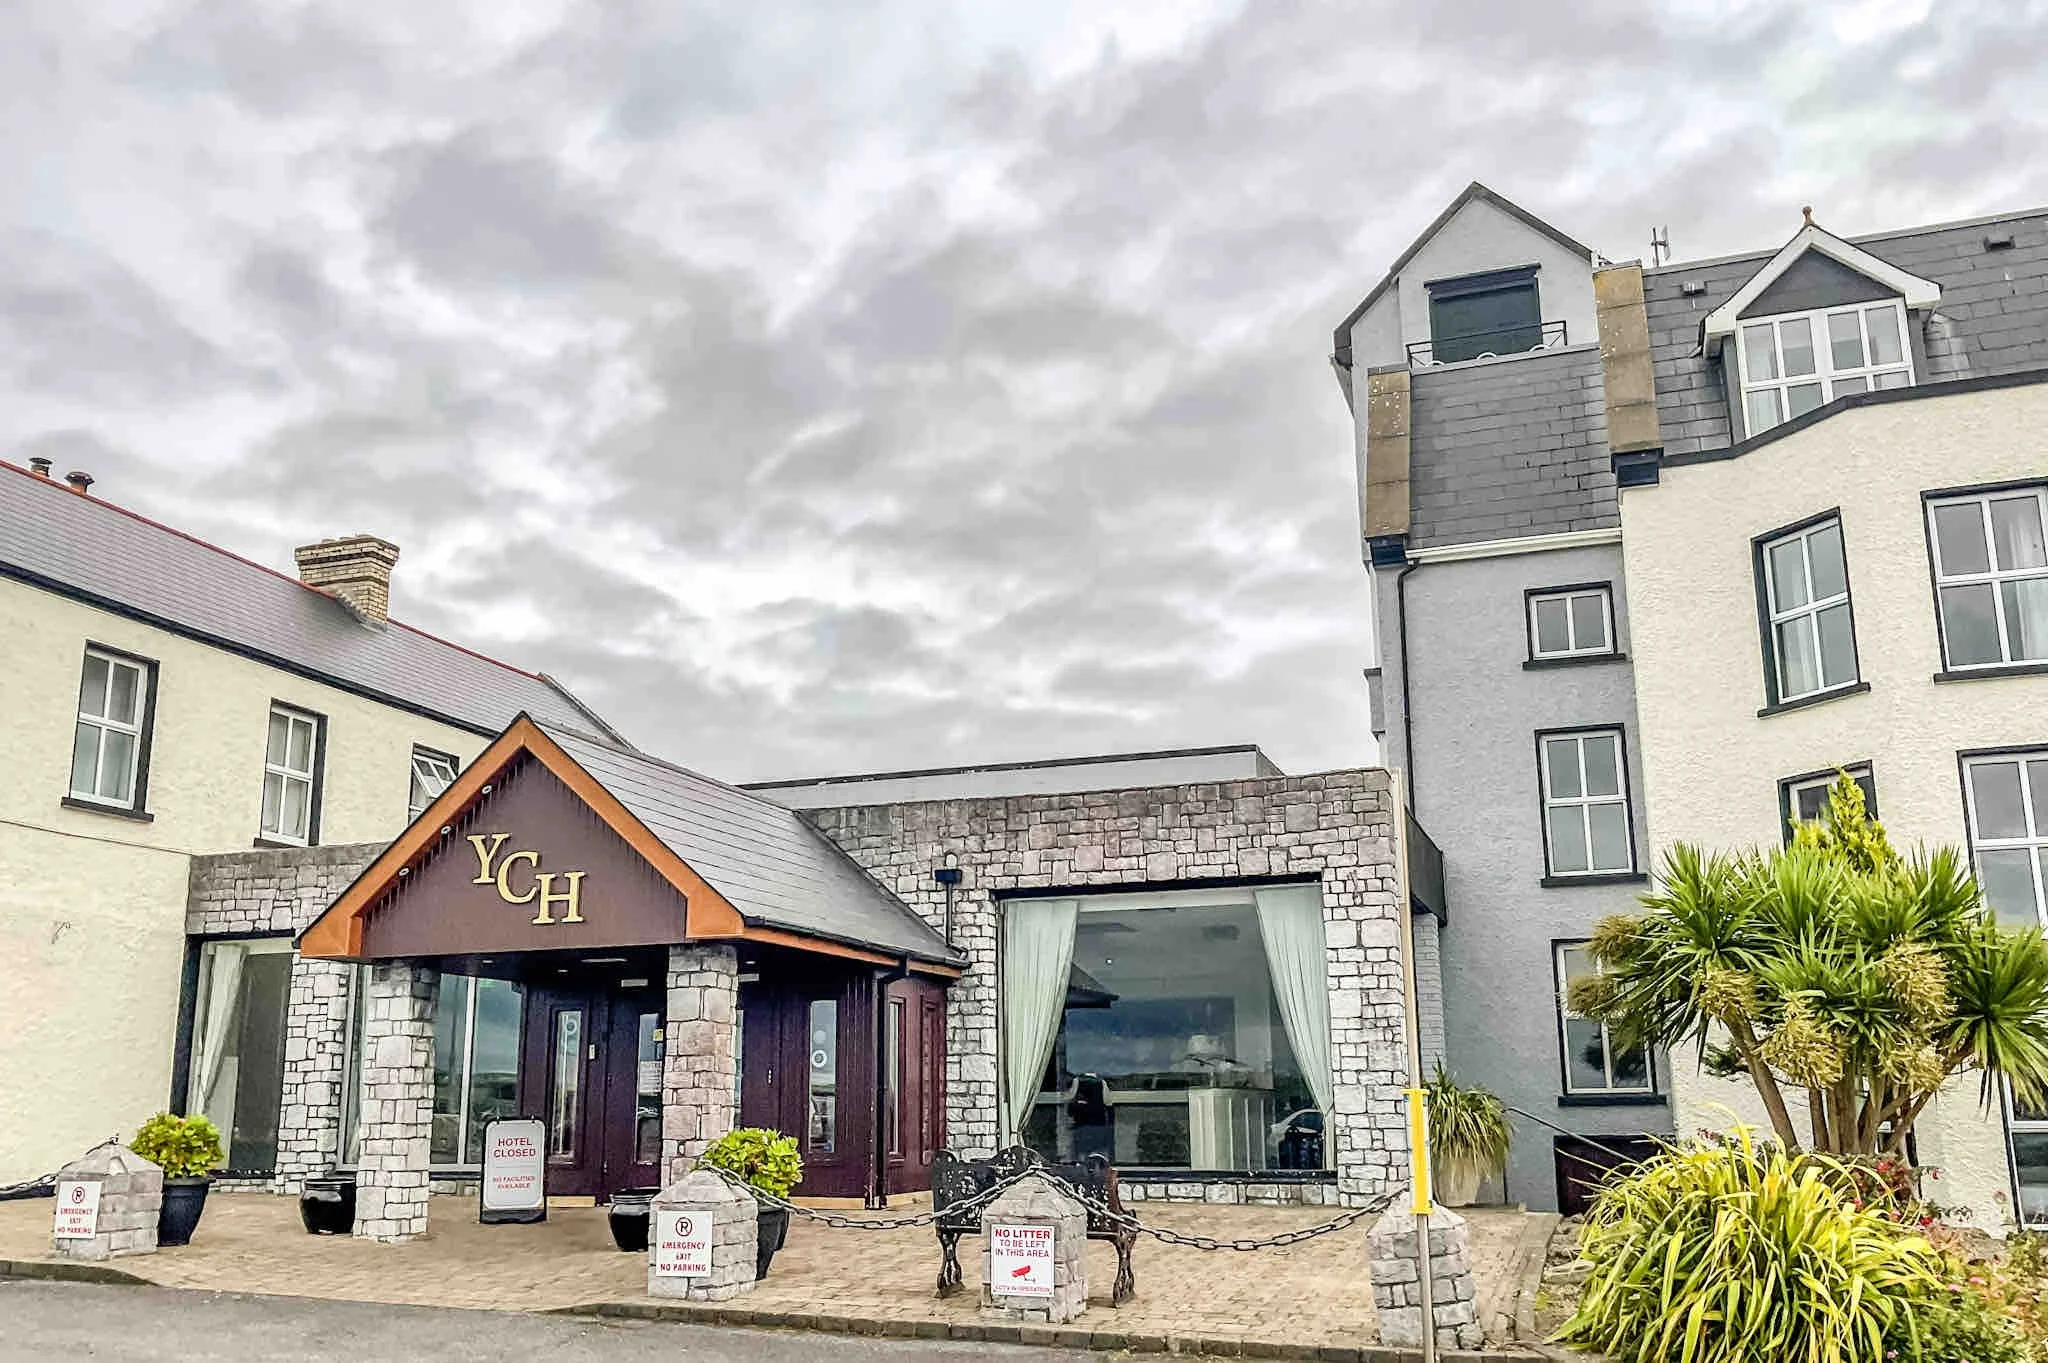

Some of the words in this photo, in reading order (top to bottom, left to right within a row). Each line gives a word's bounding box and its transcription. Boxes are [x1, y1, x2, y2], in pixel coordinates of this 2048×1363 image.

[466, 833, 586, 924] YCH
[498, 1137, 533, 1147] HOTEL
[493, 1149, 536, 1158] CLOSED
[995, 1228, 1010, 1238] NO
[1013, 1229, 1050, 1239] LITTER
[662, 1241, 706, 1250] EMERGENCY
[1000, 1239, 1011, 1247] TO
[1012, 1239, 1024, 1248] BE
[1025, 1240, 1046, 1249] LEFT
[995, 1248, 1004, 1257] IN
[1006, 1248, 1025, 1257] THIS
[1026, 1249, 1050, 1258] AREA
[660, 1263, 671, 1272] NO
[673, 1263, 706, 1272] PARKING
